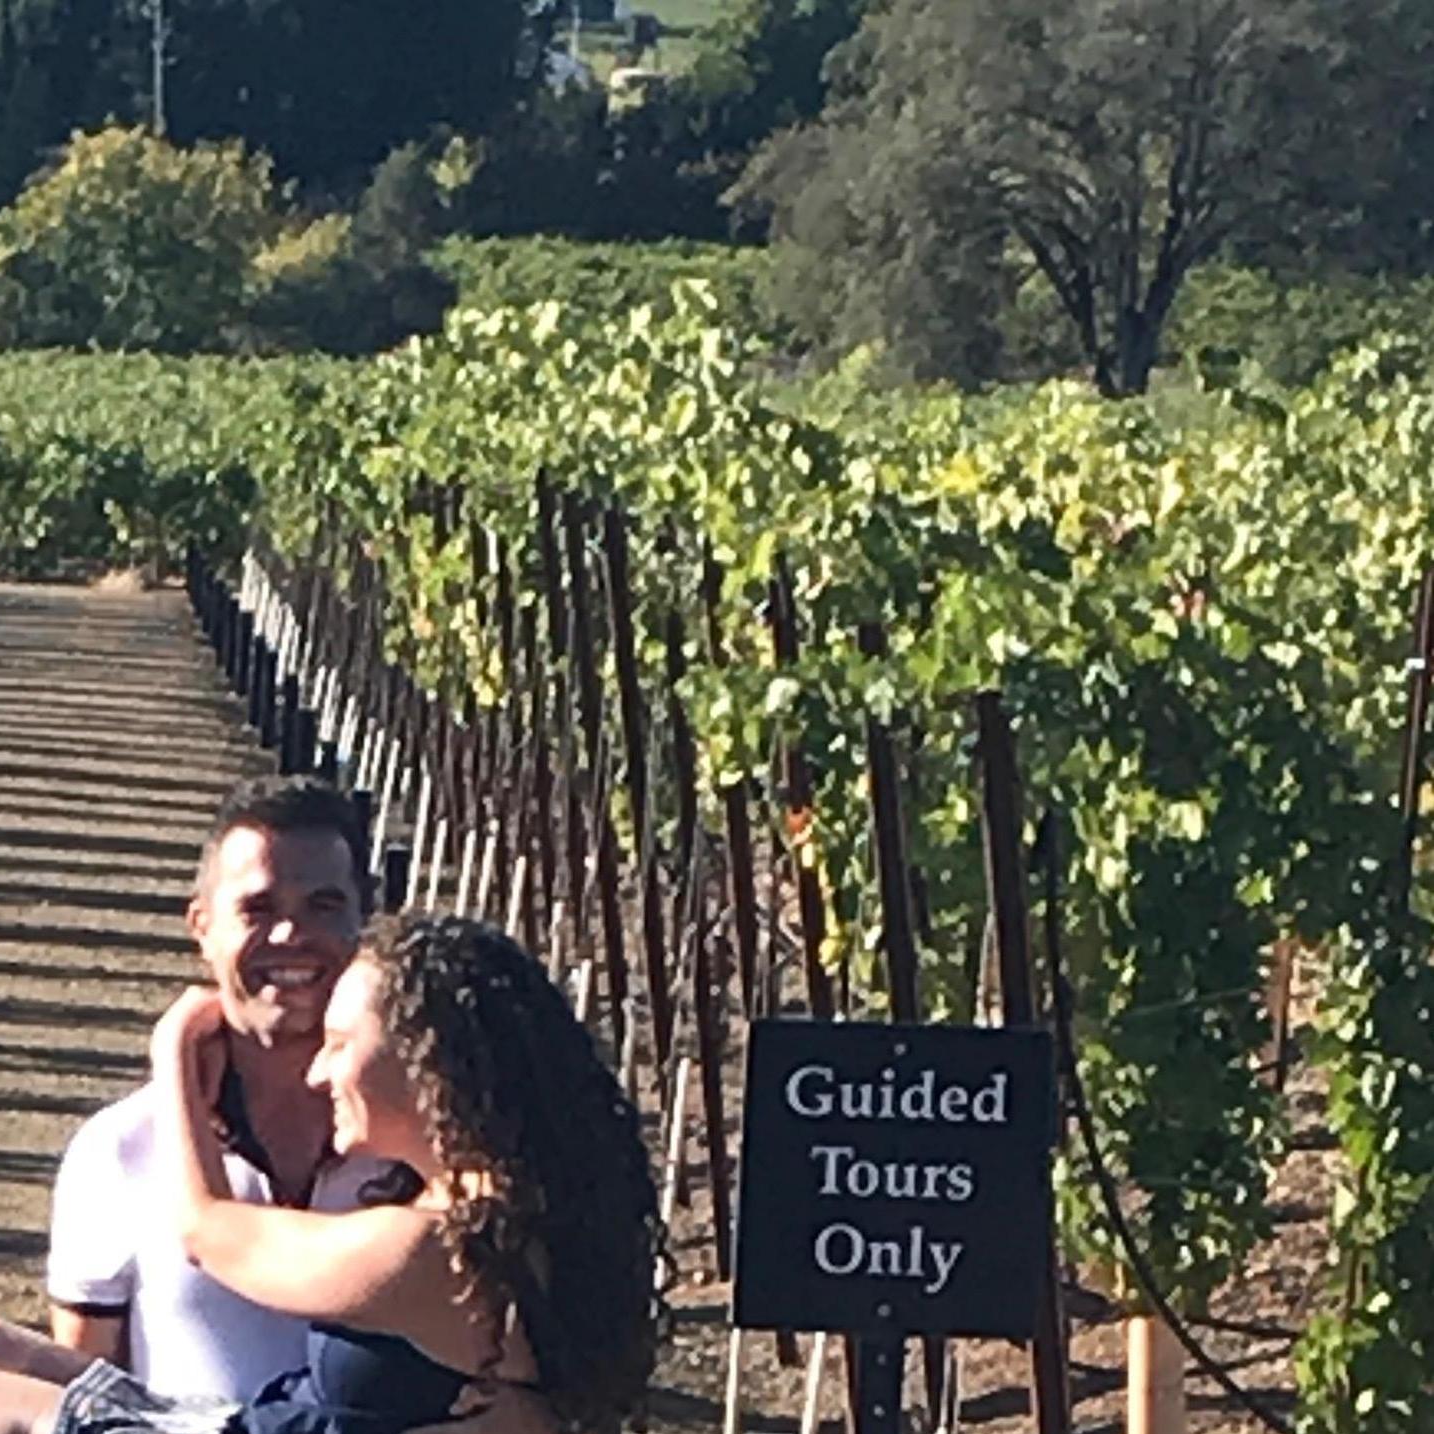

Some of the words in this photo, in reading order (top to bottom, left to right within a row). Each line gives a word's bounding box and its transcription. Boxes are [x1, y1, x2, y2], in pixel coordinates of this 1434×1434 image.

[785, 1066, 1008, 1122] Guided
[810, 1146, 974, 1201] Tours
[814, 1223, 963, 1294] Only
